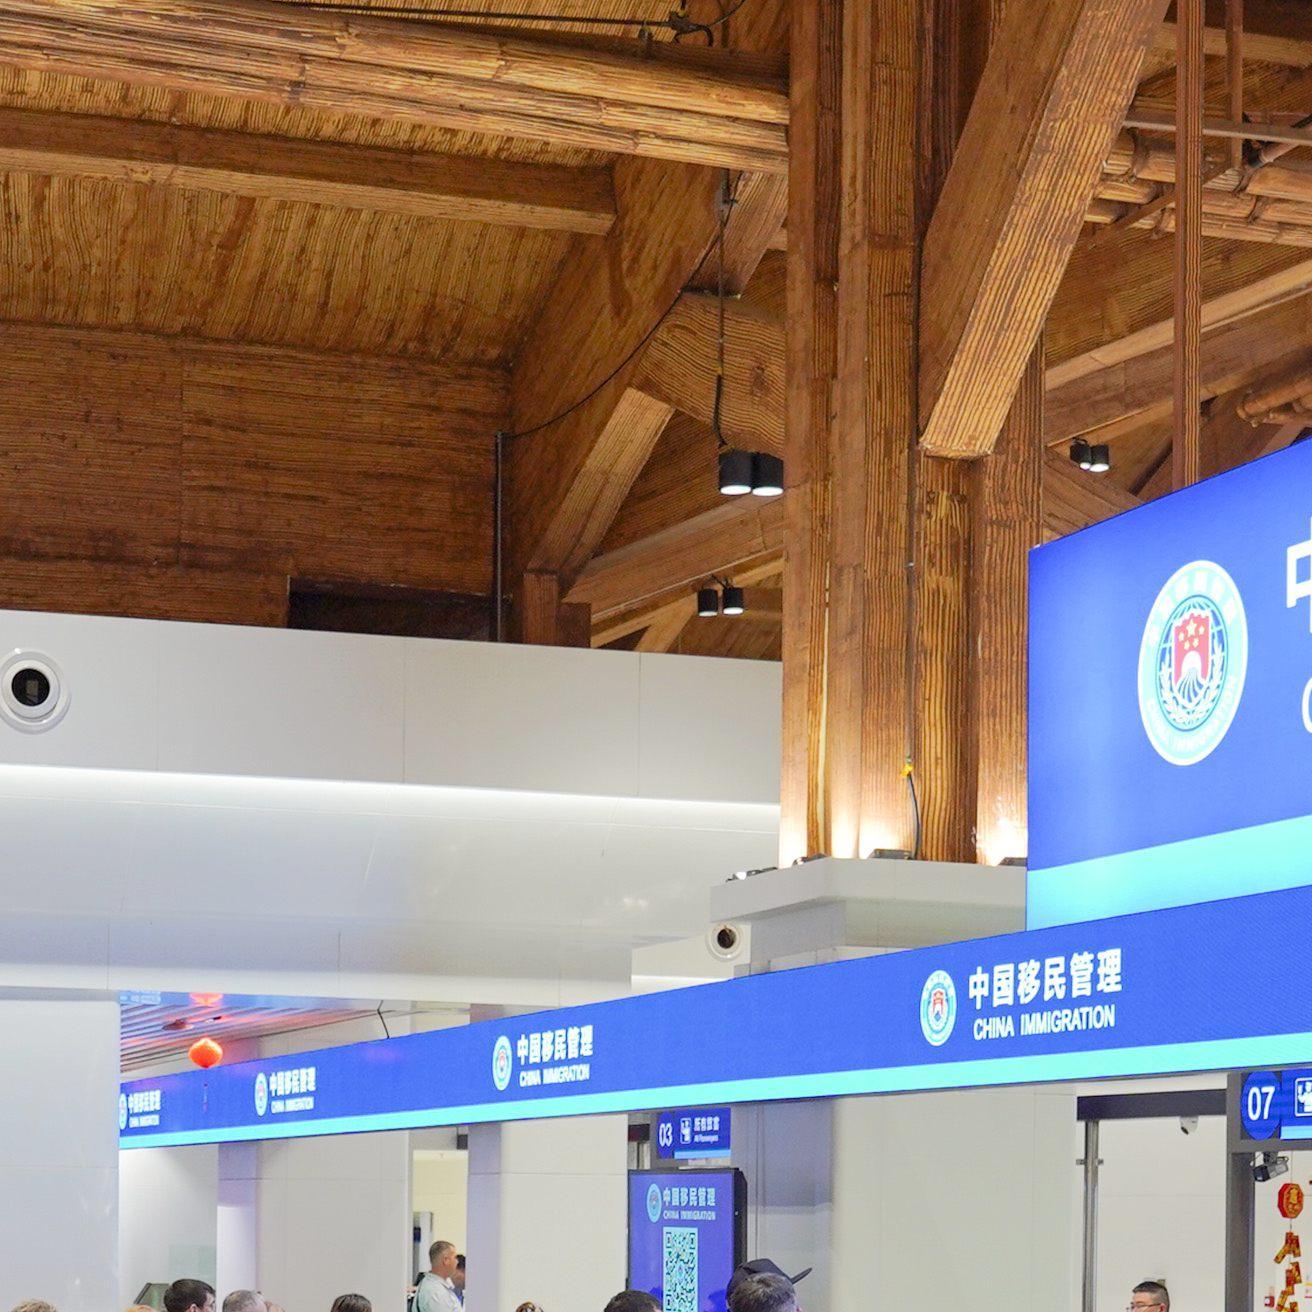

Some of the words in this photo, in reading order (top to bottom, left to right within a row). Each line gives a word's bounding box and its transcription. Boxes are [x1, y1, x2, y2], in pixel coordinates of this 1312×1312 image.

[968, 948, 1122, 1009] 中国移民管理
[973, 1015, 1014, 1041] CHINA
[1020, 1004, 1115, 1036] IMMIGRATION
[517, 1025, 593, 1065] 中国移民管理
[519, 1070, 541, 1087] CHINA
[543, 1064, 590, 1085] IMMIGRATION
[1247, 1086, 1275, 1121] 07
[659, 1123, 673, 1147] 03
[663, 1187, 716, 1206] 中国移民管理
[663, 1210, 679, 1220] CHINA
[681, 1210, 716, 1220] IMMIGRATION
